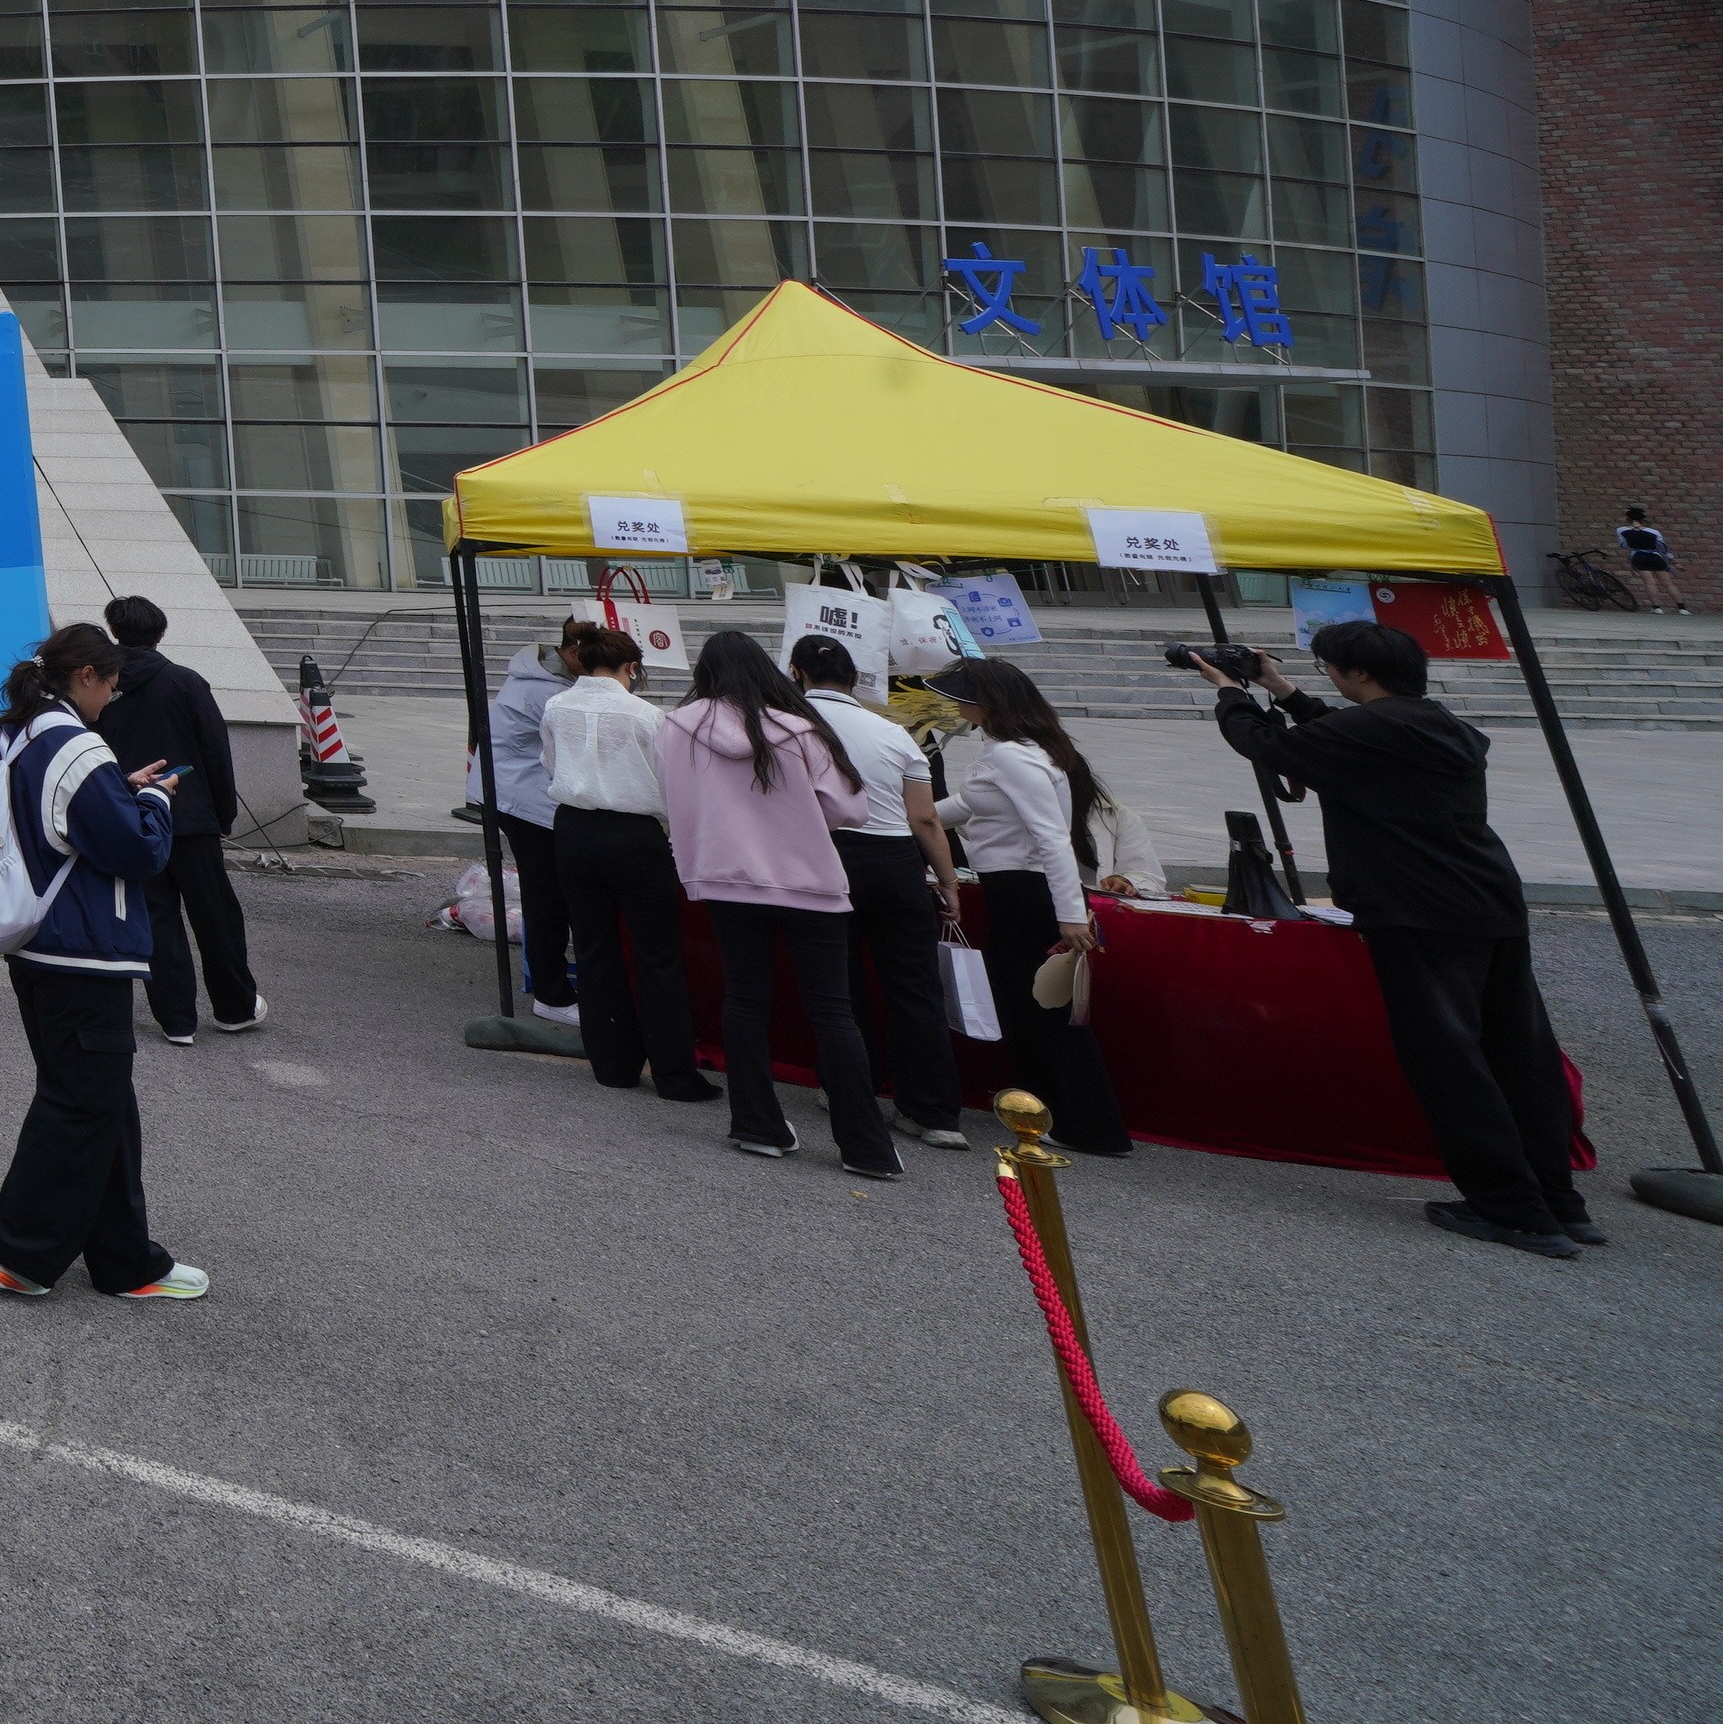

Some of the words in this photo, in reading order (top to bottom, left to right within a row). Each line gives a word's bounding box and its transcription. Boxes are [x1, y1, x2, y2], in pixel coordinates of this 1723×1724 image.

[943, 241, 1295, 348] 文体馆
[617, 521, 660, 533] 兑奖处
[1126, 536, 1180, 551] 兑奖处
